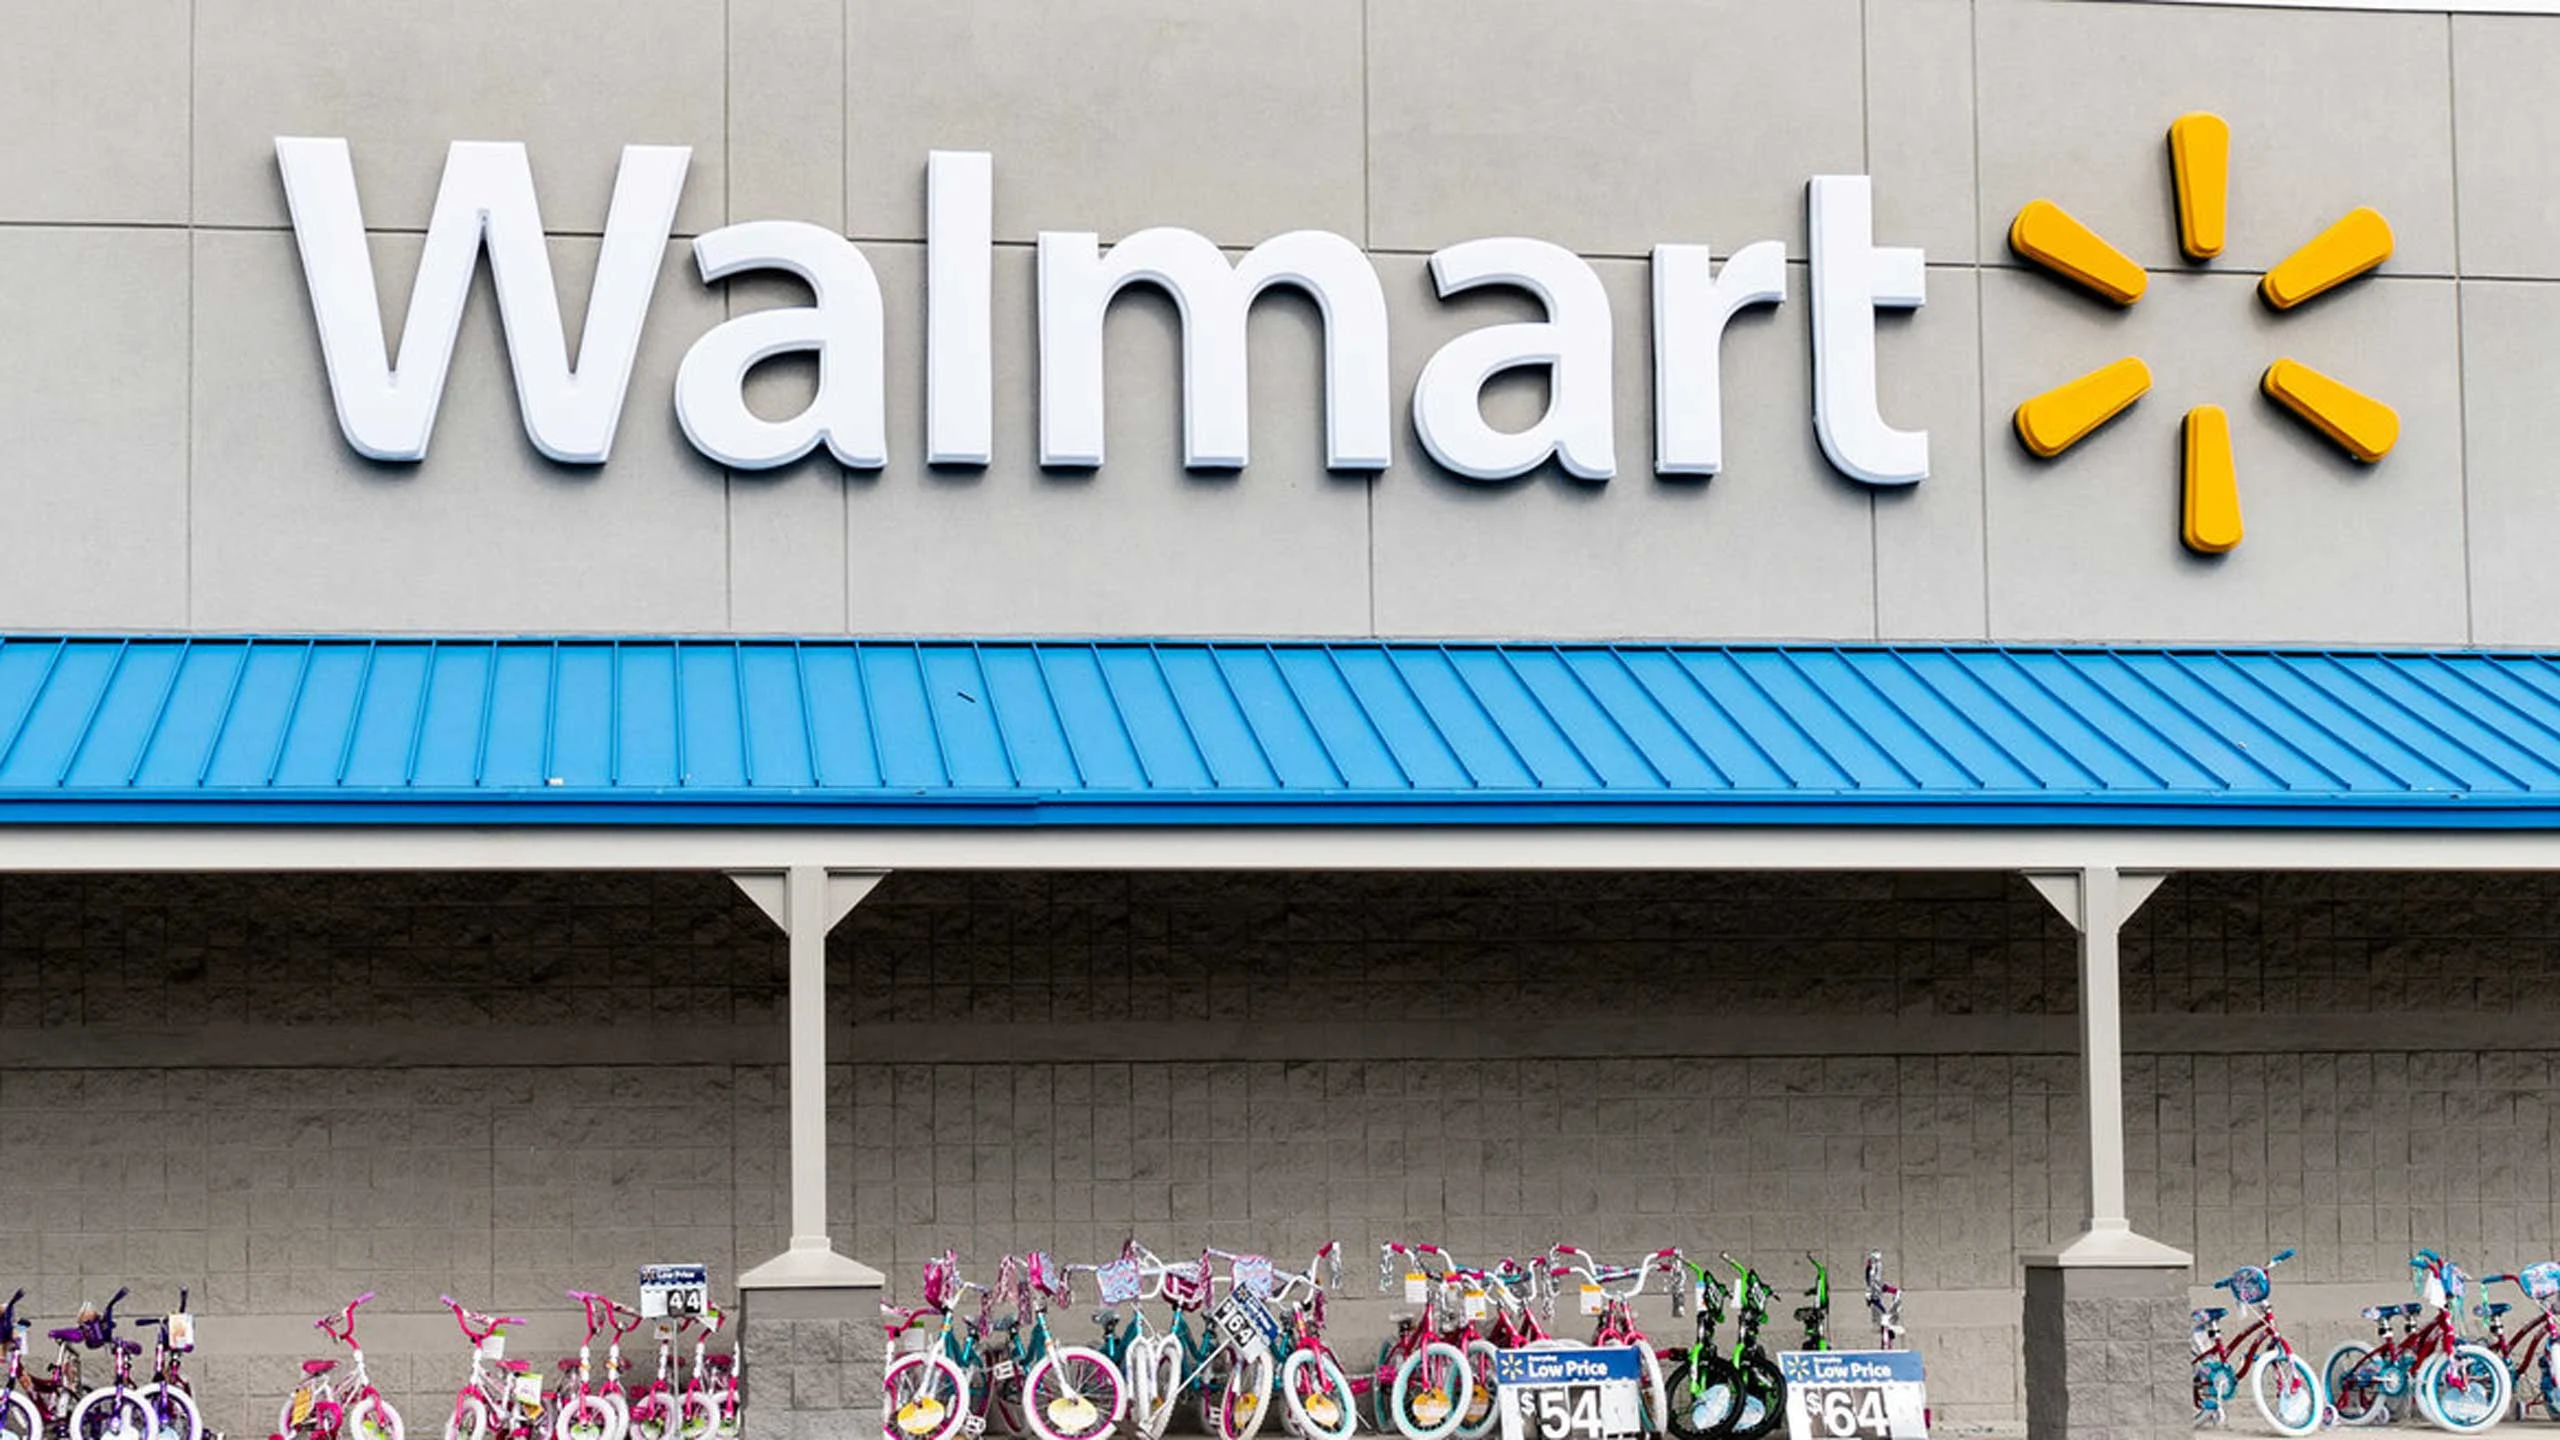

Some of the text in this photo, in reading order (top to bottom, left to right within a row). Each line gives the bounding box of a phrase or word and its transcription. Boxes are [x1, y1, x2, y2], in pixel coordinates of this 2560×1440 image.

[275, 136, 1929, 485] Walmart
[670, 1291, 700, 1310] 44
[1528, 1359, 1608, 1378] Low Price
[1815, 1361, 1892, 1379] Low Price
